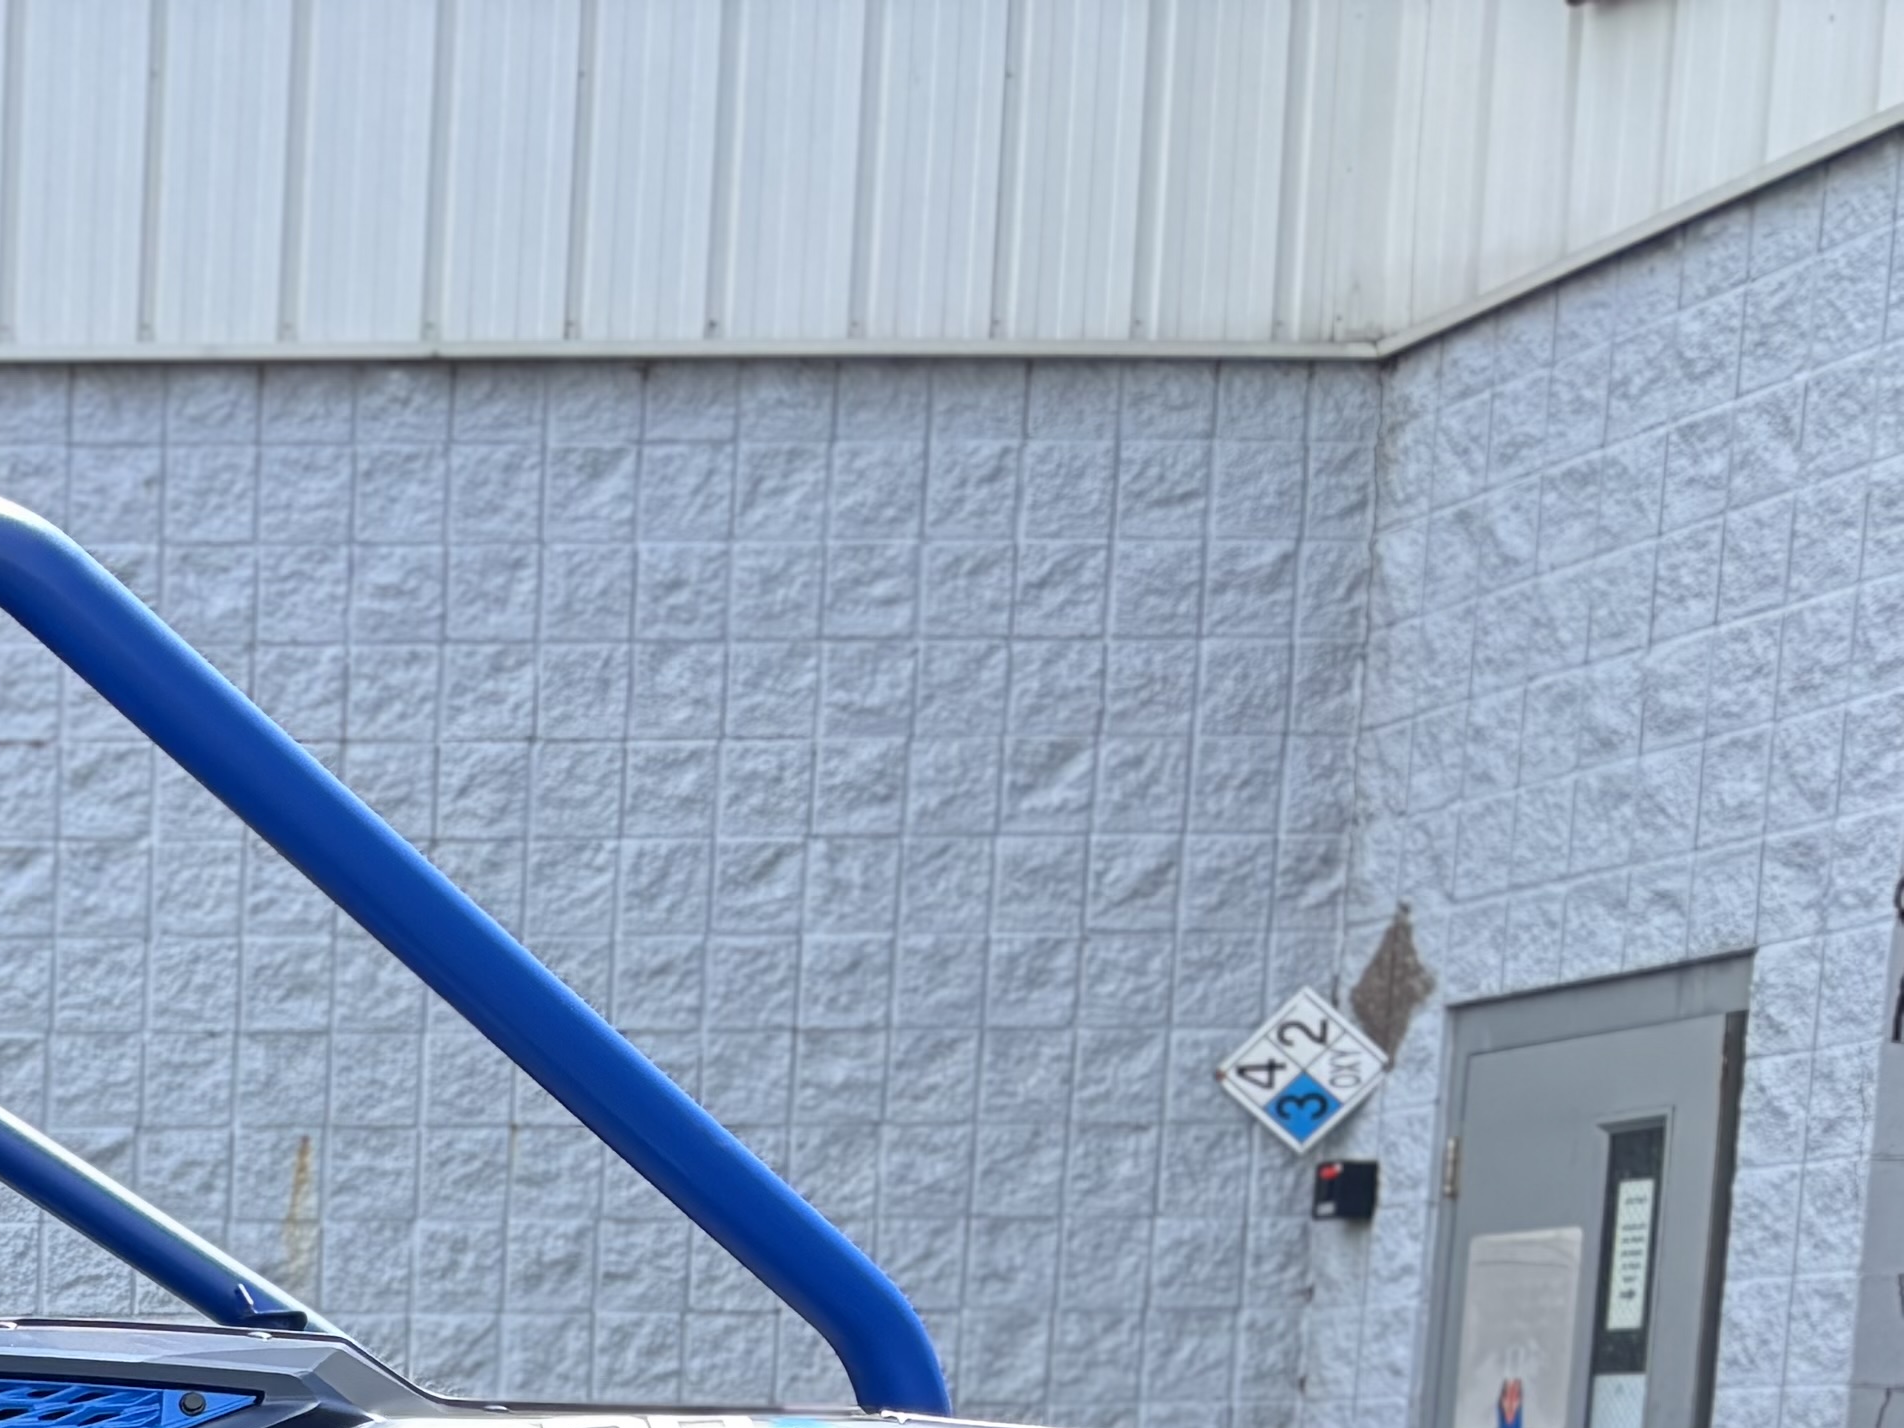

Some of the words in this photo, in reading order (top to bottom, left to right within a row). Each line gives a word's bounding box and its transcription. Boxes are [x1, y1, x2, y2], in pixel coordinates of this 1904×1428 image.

[1277, 1019, 1328, 1046] 2
[1236, 1059, 1286, 1089] 4
[1329, 1050, 1361, 1088] OXY
[1276, 1093, 1327, 1120] 3
